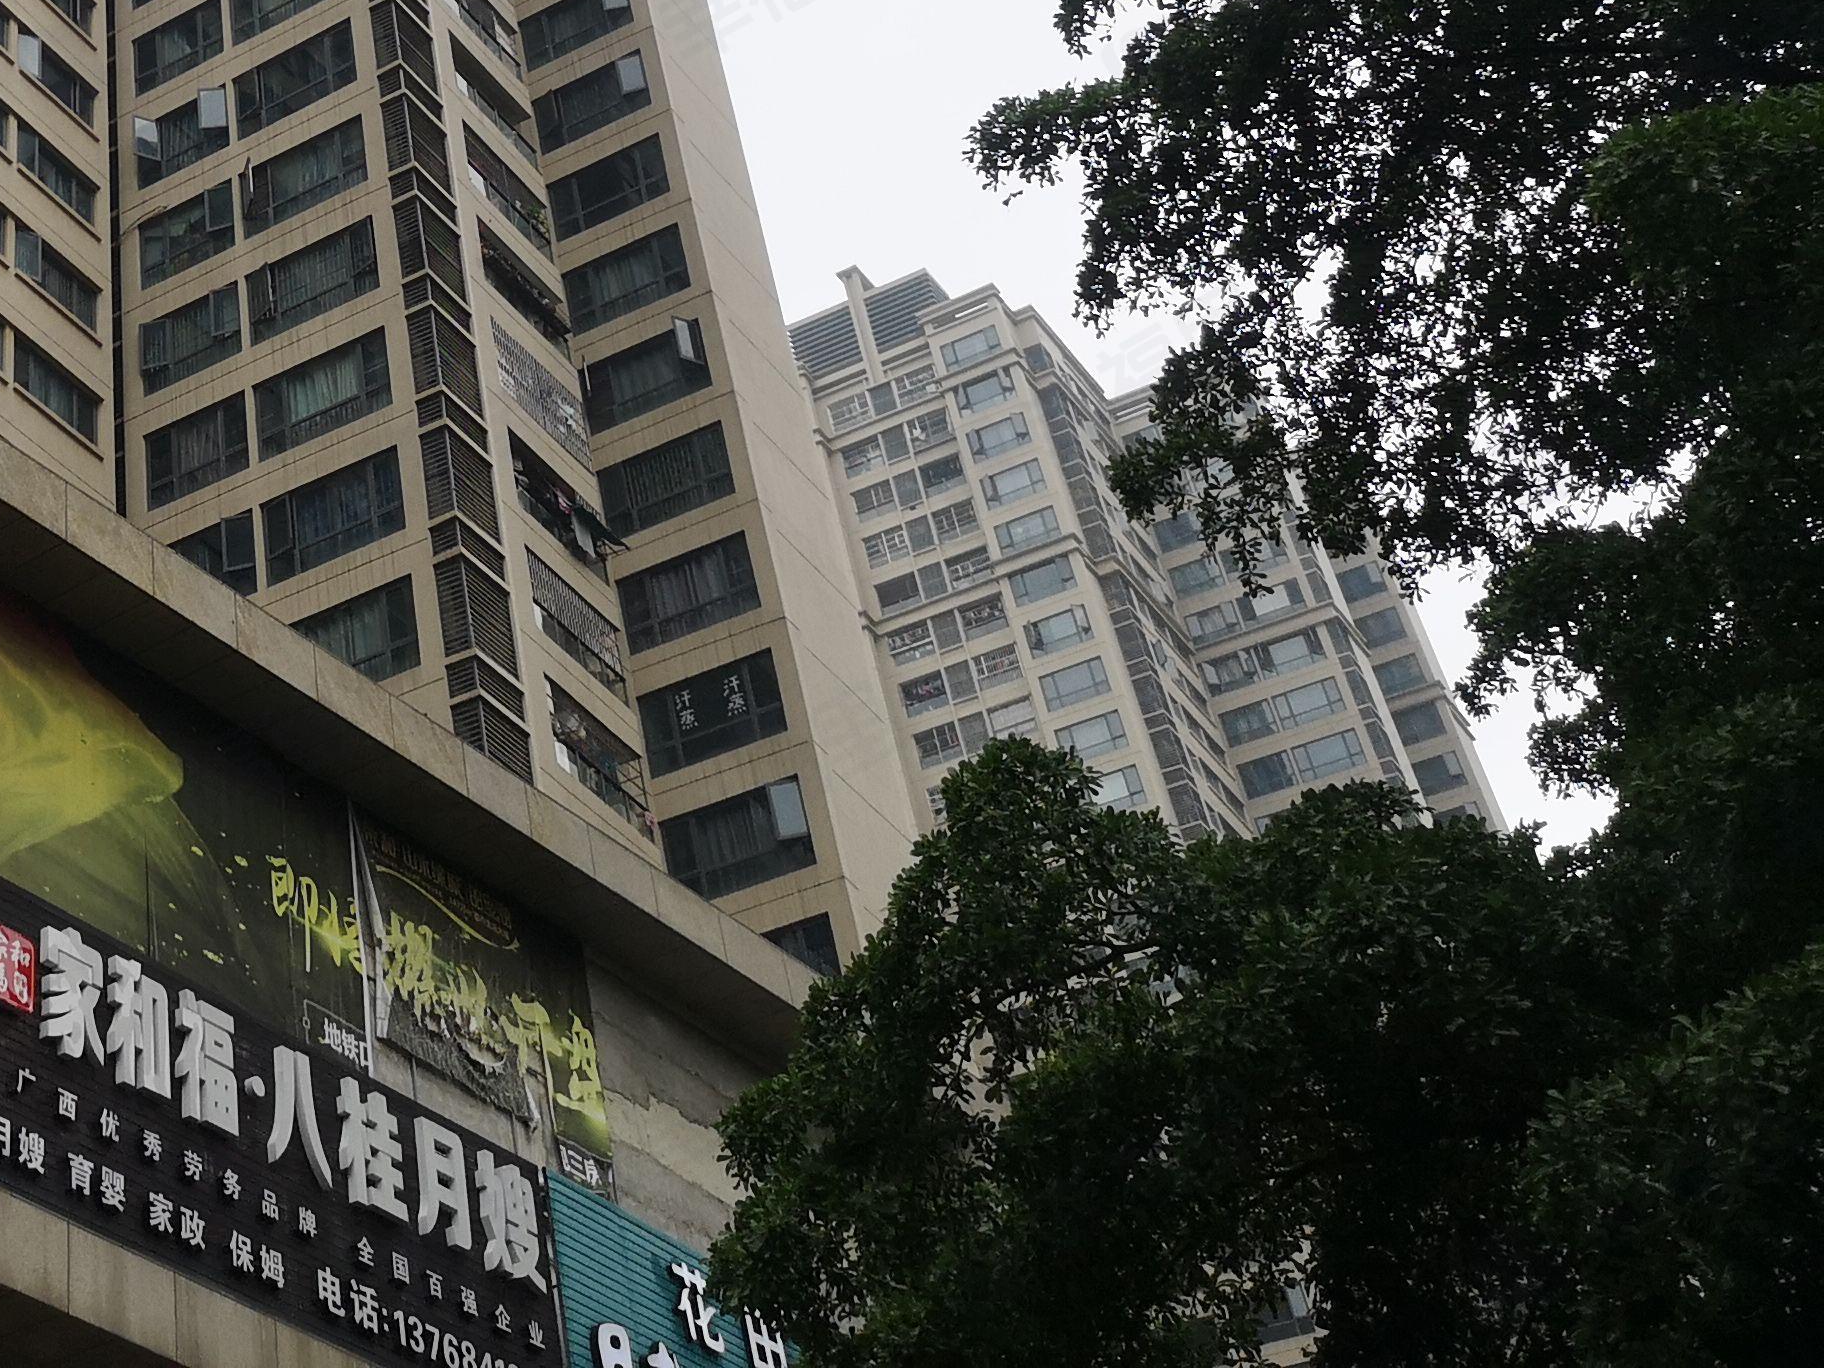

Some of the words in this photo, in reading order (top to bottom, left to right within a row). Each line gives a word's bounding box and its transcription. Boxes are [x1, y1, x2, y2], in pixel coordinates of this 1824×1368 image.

[675, 690, 698, 730] 汗蒸
[723, 675, 747, 716] 汗蒸
[16, 1068, 318, 1238] 广西优秀劳务品牌
[357, 1236, 546, 1350] 全国百强企业
[68, 1151, 127, 1213] 育婴
[148, 1191, 207, 1251] 家政
[229, 1229, 285, 1289] 保姆
